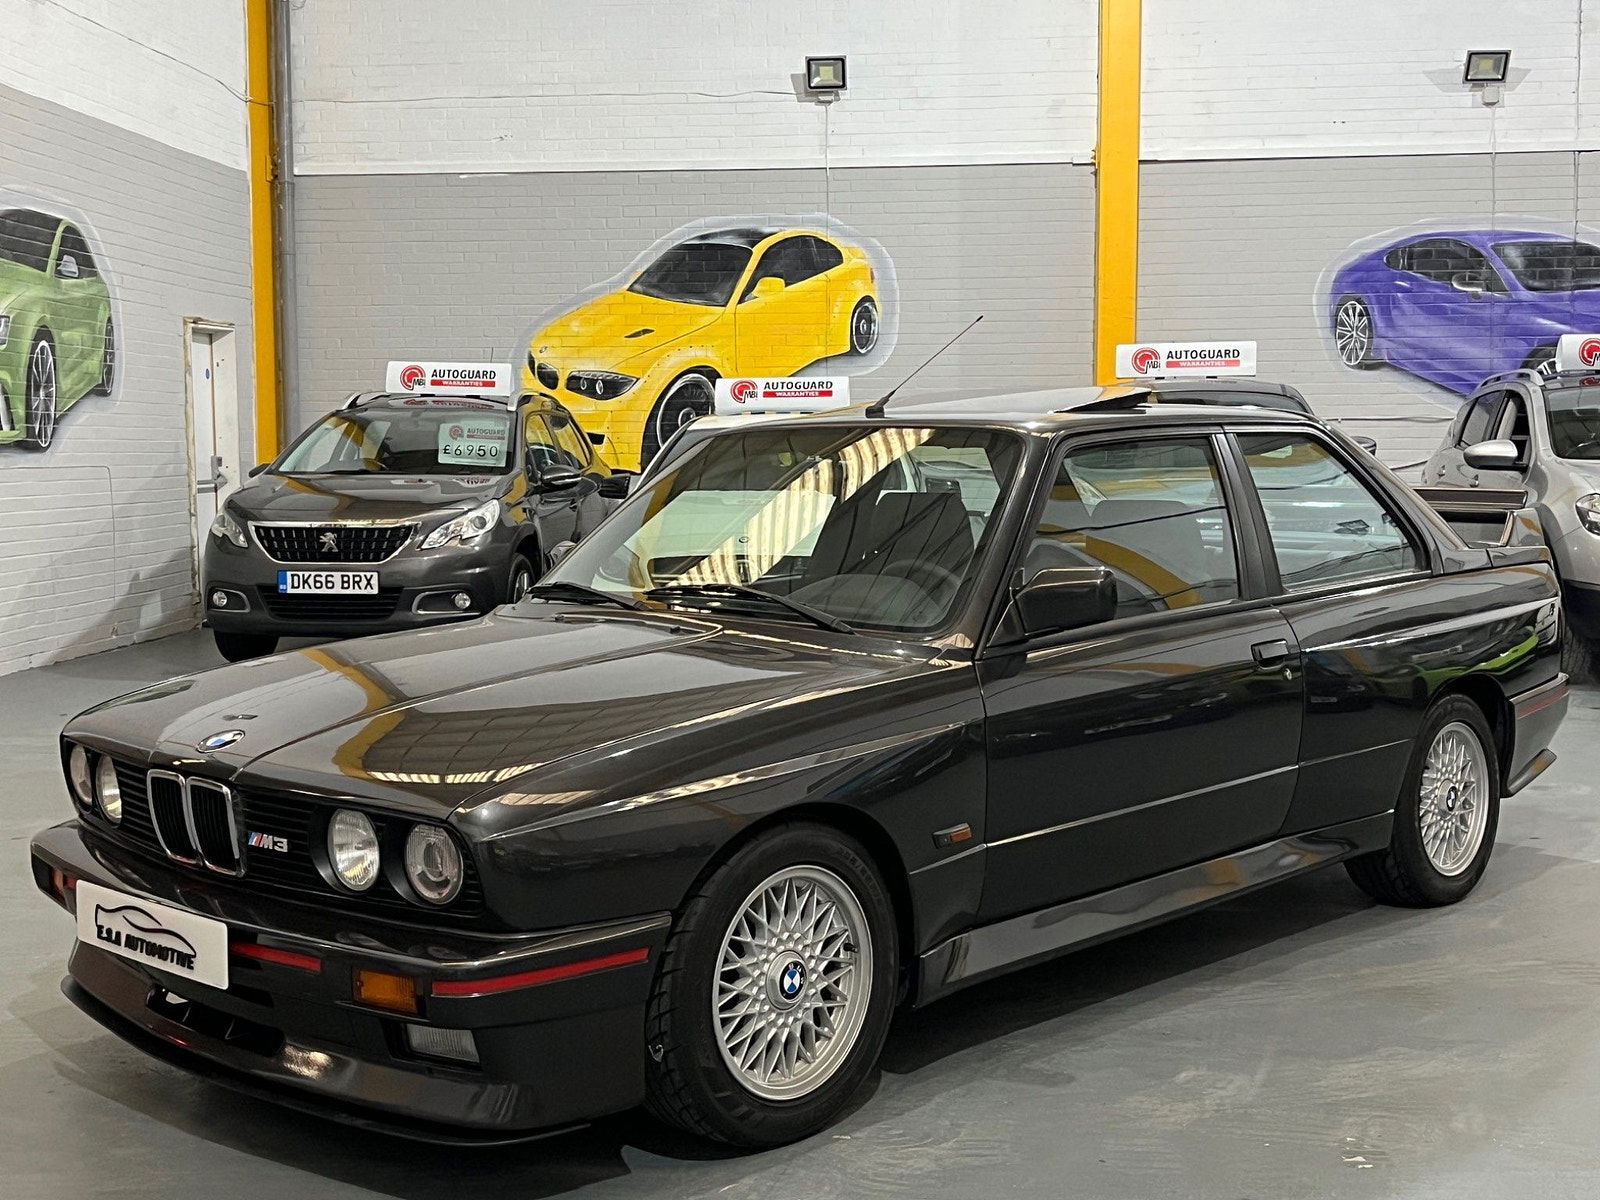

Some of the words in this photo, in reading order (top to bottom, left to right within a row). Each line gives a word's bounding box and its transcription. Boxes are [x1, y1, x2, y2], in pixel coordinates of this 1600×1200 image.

[1167, 349, 1240, 359] AUTOGUARD
[431, 369, 496, 379] AUTOGUARD
[763, 381, 833, 390] AUTOGUARD
[443, 444, 498, 457] £6950
[290, 573, 335, 590] DK66
[340, 574, 374, 590] BRX
[258, 833, 288, 852] M3
[124, 933, 195, 970] AUTOMOTIVE
